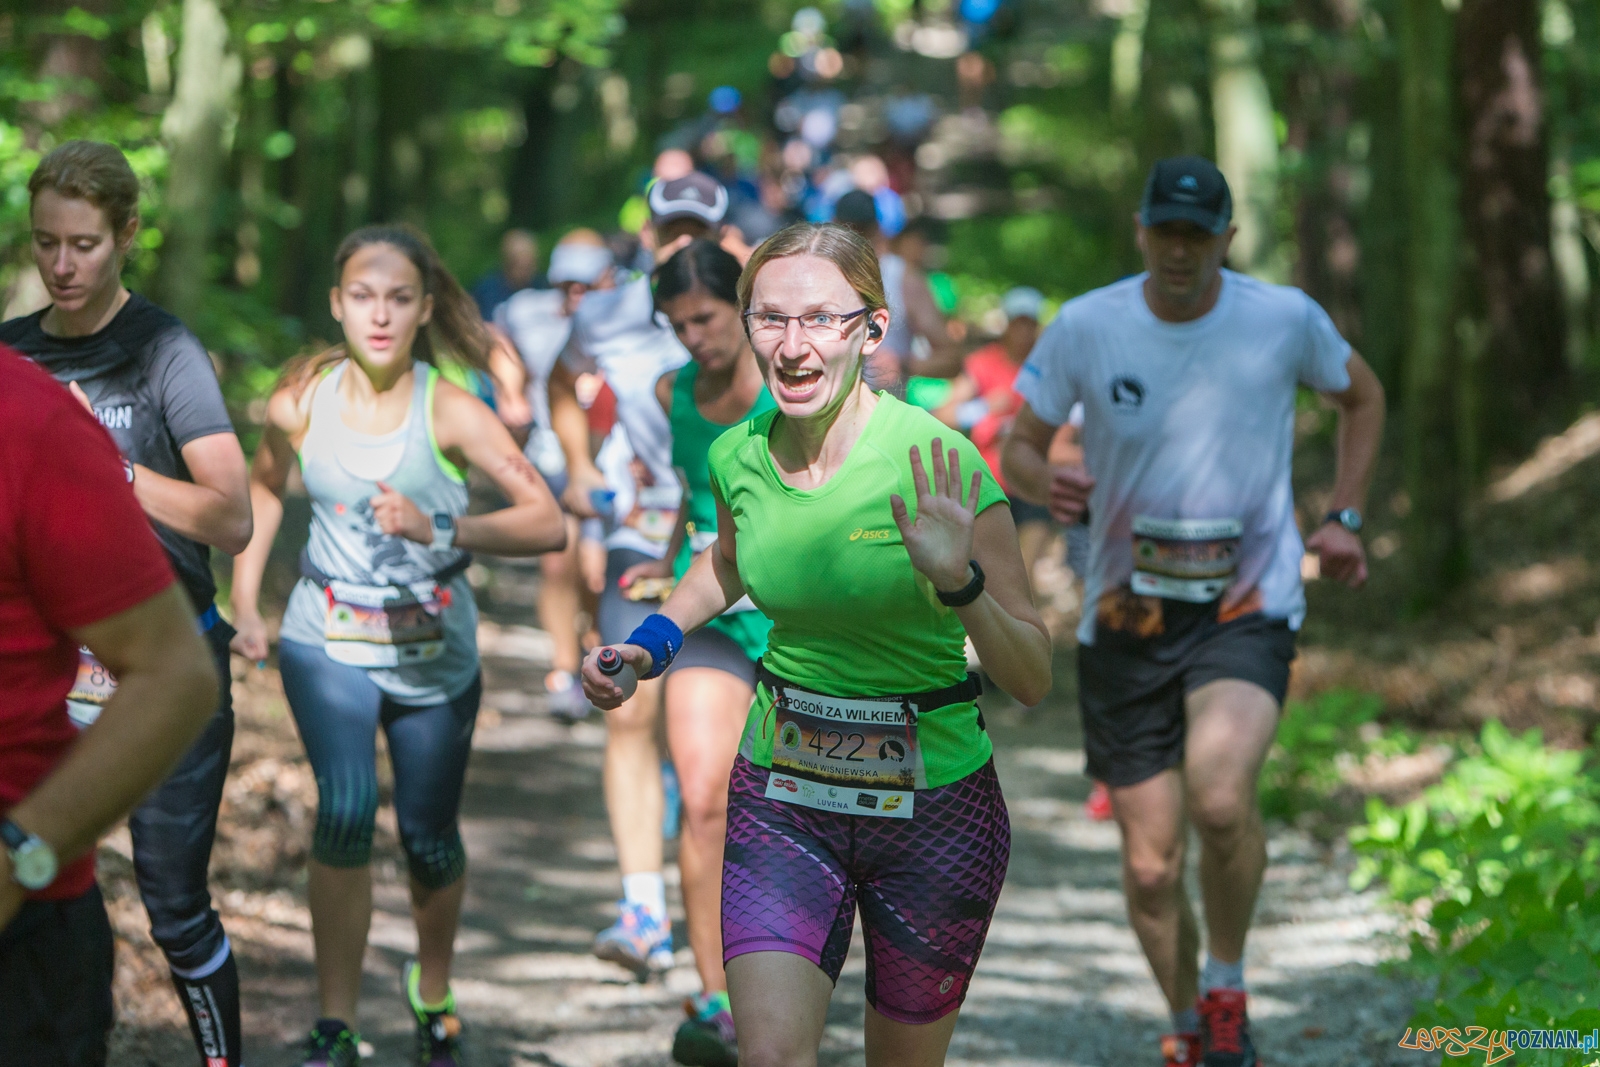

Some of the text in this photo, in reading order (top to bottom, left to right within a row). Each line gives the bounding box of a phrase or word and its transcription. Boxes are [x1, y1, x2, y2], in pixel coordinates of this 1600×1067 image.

[787, 697, 905, 723] POGOŃ ZA WILKIEM
[808, 726, 866, 763] 422
[798, 759, 879, 778] ANNA WIŚNIEWSKA
[817, 798, 849, 810] LUVENA
